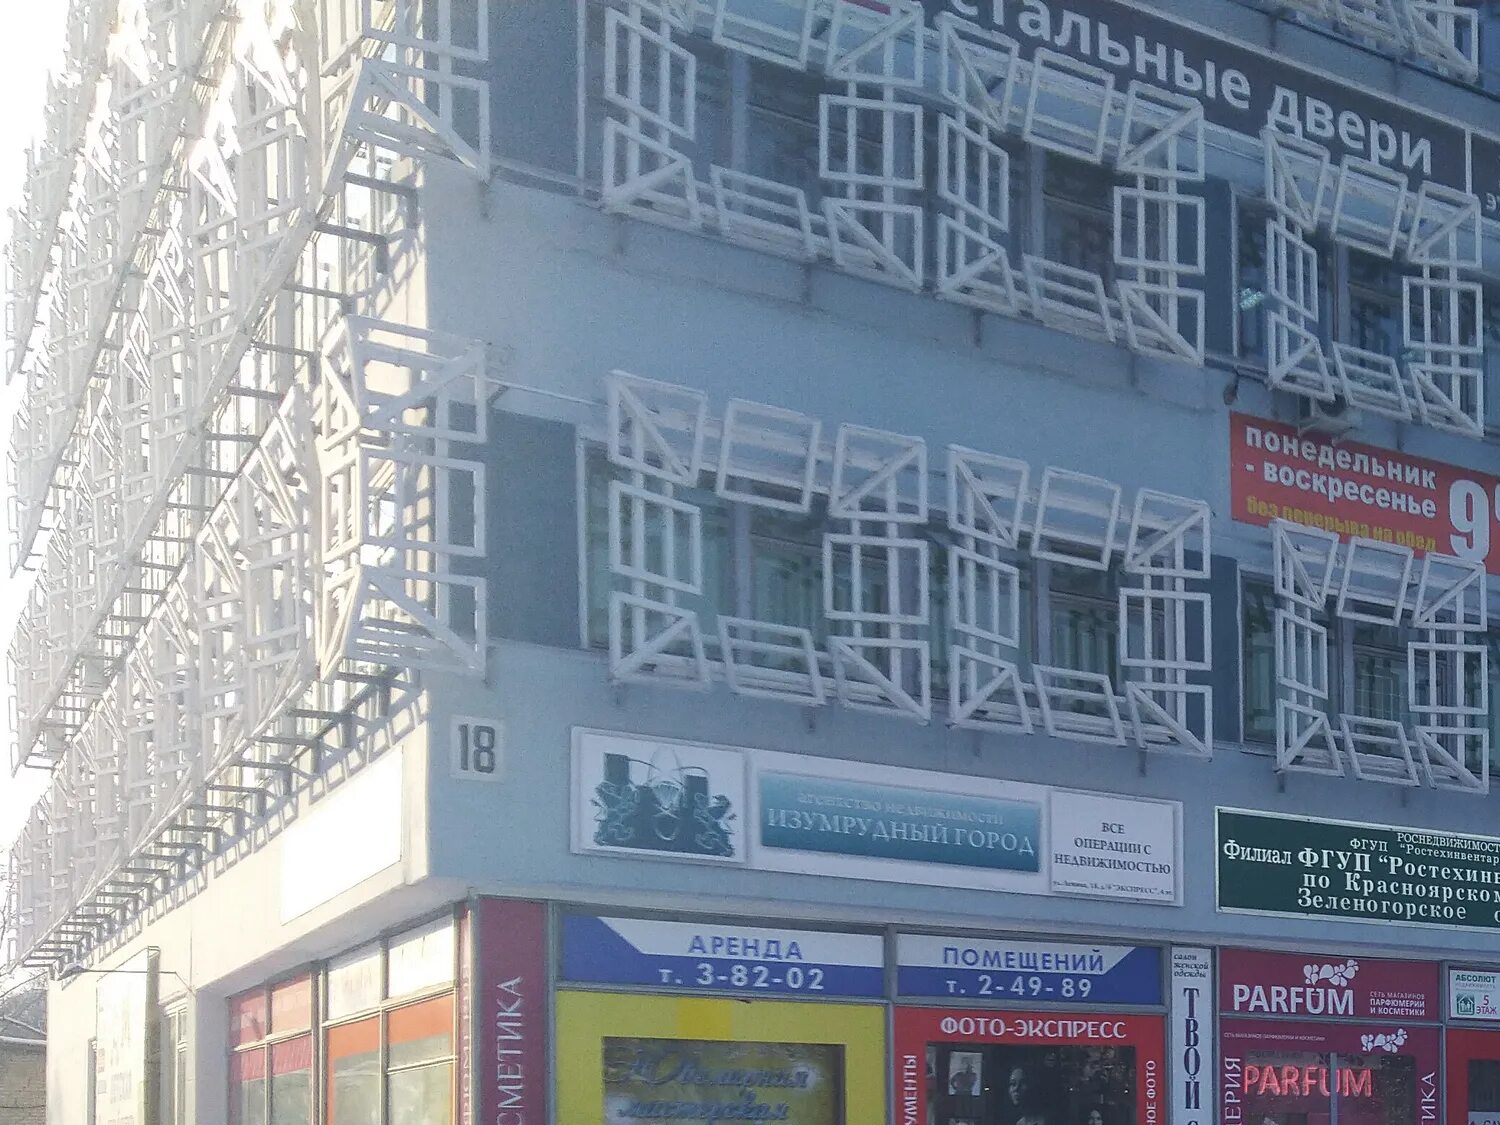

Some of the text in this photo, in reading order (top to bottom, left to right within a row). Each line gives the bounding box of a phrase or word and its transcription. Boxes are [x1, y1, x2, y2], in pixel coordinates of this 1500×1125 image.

[1267, 84, 1432, 174] двери
[1245, 425, 1436, 490] понедельник
[1264, 460, 1436, 519] воскресенье
[458, 723, 496, 774] 18
[766, 808, 1036, 857] ИЗУМРУДНЫЙ ГОРОД
[1101, 821, 1125, 834] ВСЕ
[1073, 837, 1152, 856] ОПЕРАЦИИ С
[1223, 838, 1292, 866] Филиал
[1297, 847, 1371, 873] ФГУП
[1350, 838, 1388, 852] ФГУП
[1053, 852, 1172, 875] НЕДВИЖИМОСТЬЮ
[1303, 872, 1331, 890] по
[1297, 886, 1467, 921] Зеленогорское
[687, 934, 804, 961] АРЕНДА
[942, 947, 1104, 972] ПОМЕЩЕНИЙ
[659, 962, 826, 991] т. 3-82-02
[946, 974, 1092, 998] т. 2-49-89
[1456, 974, 1497, 983] АБСОЛЮТ
[1370, 998, 1426, 1009] ПАРФЮМЕРИИ
[1386, 991, 1425, 1000] МАГАЗИНОВ
[1483, 994, 1490, 1006] 5
[1370, 1006, 1426, 1017] И КОСМЕТИКИ
[1476, 1005, 1497, 1015] ЭТАЖ
[940, 1017, 1127, 1039] ФОТО-ЭКСПРЕСС
[1145, 1060, 1157, 1099] ФОТО
